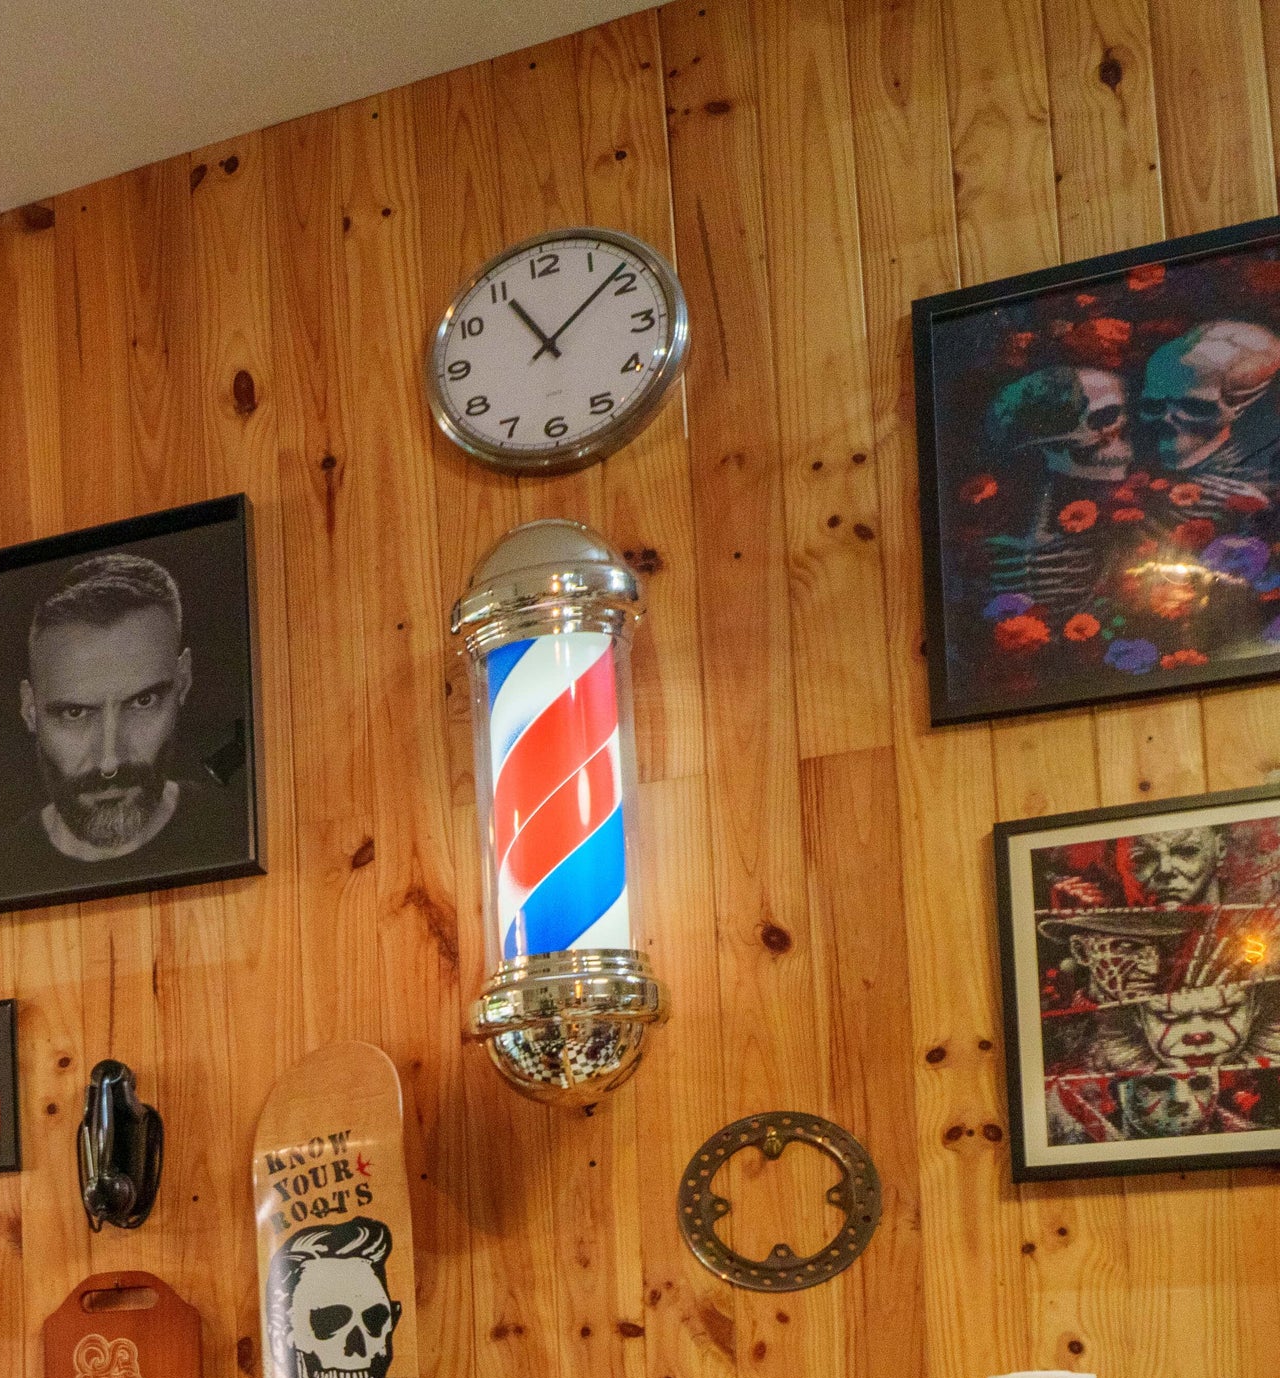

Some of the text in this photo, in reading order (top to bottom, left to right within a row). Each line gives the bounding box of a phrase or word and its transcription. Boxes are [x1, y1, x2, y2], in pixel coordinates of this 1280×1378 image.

[530, 254, 560, 279] 12
[587, 252, 593, 272] 1
[490, 281, 507, 303] 11
[614, 273, 637, 296] 2
[461, 317, 484, 339] 10
[630, 309, 655, 333] 3
[447, 360, 471, 381] 9
[620, 353, 644, 374] 4
[465, 395, 490, 416] 8
[590, 392, 614, 414] 5
[499, 417, 520, 438] 7
[544, 417, 568, 437] 6
[265, 1129, 351, 1175] KNOW
[273, 1159, 354, 1202] YOUR
[269, 1182, 373, 1235] ROOTS
